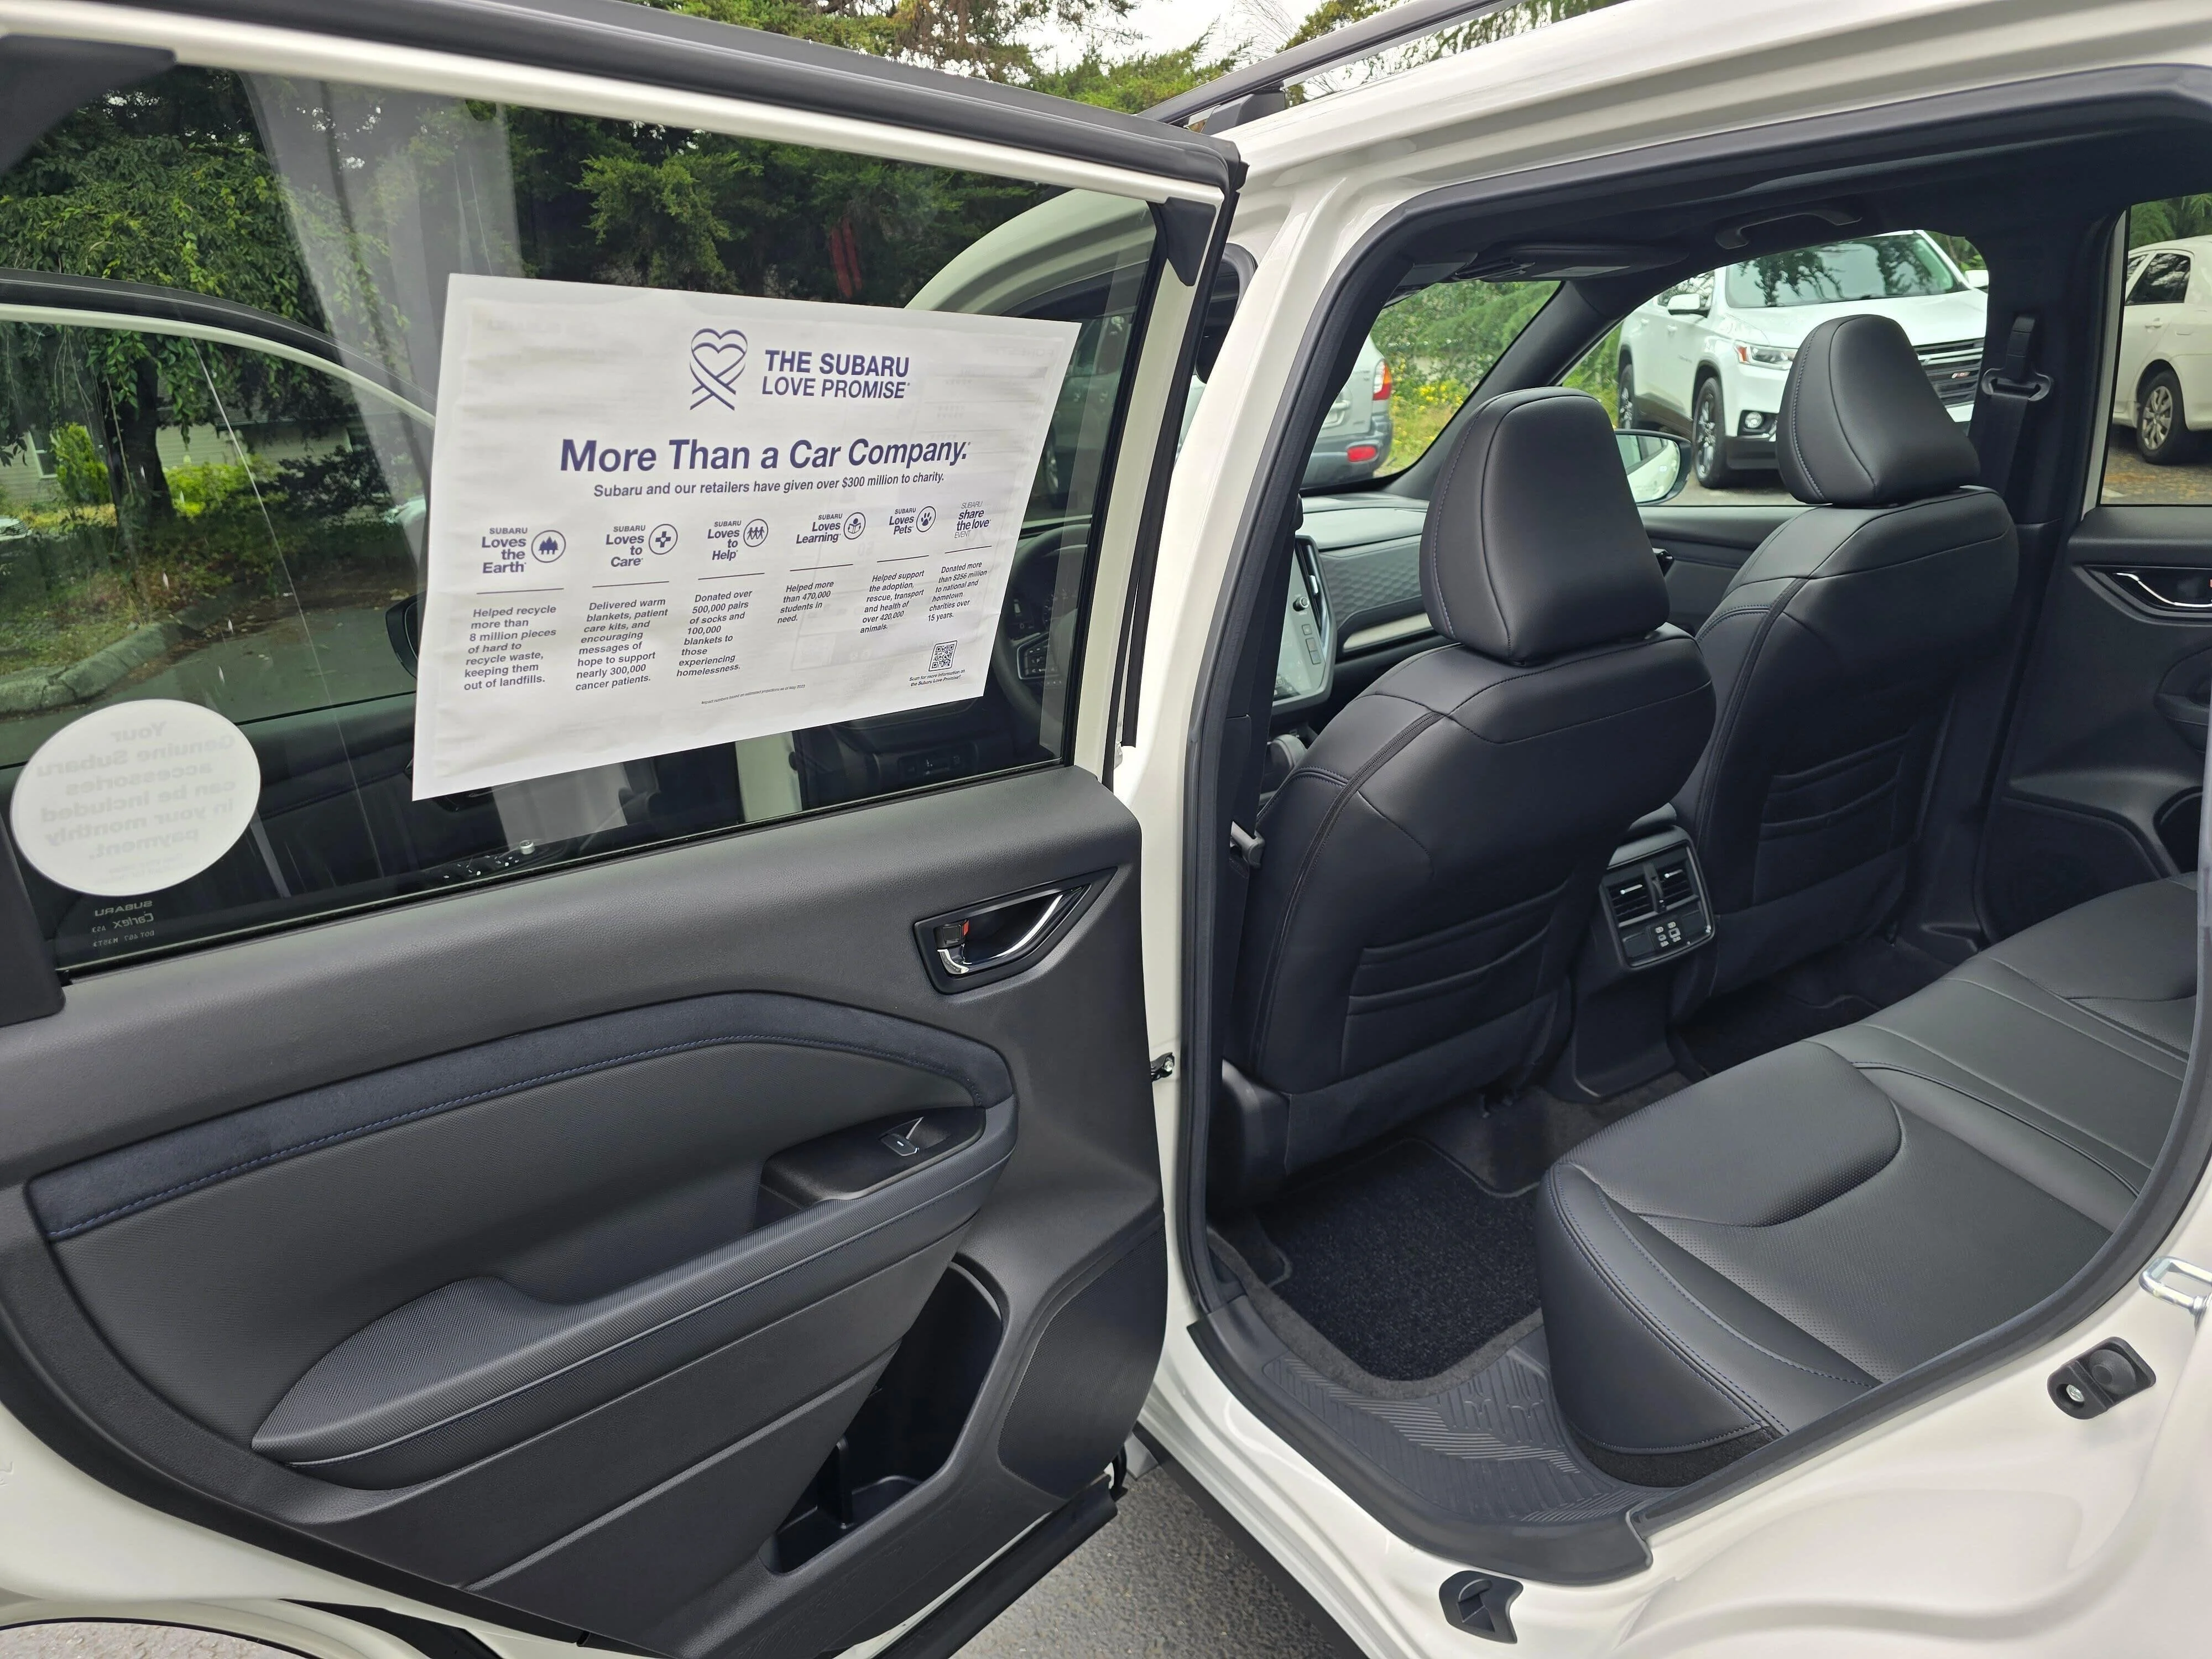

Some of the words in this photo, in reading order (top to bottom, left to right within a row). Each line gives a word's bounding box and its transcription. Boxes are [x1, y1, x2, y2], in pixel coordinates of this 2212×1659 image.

[765, 349, 812, 373] THE
[820, 353, 909, 377] SUBARU
[762, 376, 816, 396] LOVE
[822, 380, 905, 398] PROMISE
[561, 439, 656, 472] More
[669, 439, 749, 469] Than
[761, 447, 778, 469] a
[790, 440, 841, 468] Car
[594, 484, 642, 497] Subaru
[646, 482, 670, 494] and
[675, 485, 696, 493] our
[701, 482, 749, 493] retailers
[754, 481, 780, 492] have
[784, 480, 813, 492] given
[817, 480, 839, 489] over
[842, 477, 864, 489] $300
[867, 474, 898, 486] million
[901, 475, 910, 483] to
[913, 472, 943, 483] charity.
[958, 509, 984, 520] share
[889, 516, 914, 525] Loves
[957, 520, 971, 531] the
[812, 522, 841, 531] Loves
[606, 534, 644, 545] Loves
[708, 529, 740, 539] Loves
[482, 536, 526, 547] Loves
[728, 539, 738, 548] to
[501, 549, 525, 560] the
[630, 546, 643, 555] to
[941, 564, 966, 573] Donated
[872, 573, 897, 582] Helped
[898, 570, 924, 580] support
[786, 582, 813, 593] Helped
[882, 582, 914, 591] adoption,
[943, 582, 967, 591] national
[695, 592, 731, 602] Donated
[802, 591, 831, 600] 470,000
[895, 589, 924, 599] transport
[932, 592, 963, 603] hometown
[589, 600, 637, 610] Delivered
[692, 603, 726, 614] 500,000
[728, 601, 749, 612] pairs
[780, 603, 813, 613] students
[864, 604, 878, 613] and
[880, 603, 900, 611] health
[930, 602, 955, 611] charities
[473, 607, 513, 618] Helped
[517, 605, 556, 616] recycle
[587, 612, 631, 622] blankets,
[634, 609, 668, 620] patient
[880, 611, 904, 620] 420,000
[504, 619, 528, 627] than
[701, 615, 727, 623] socks
[729, 612, 745, 620] and
[778, 614, 797, 623] need.
[936, 613, 953, 622] years.
[688, 625, 721, 635] 100,000
[860, 624, 888, 633] animals.
[469, 633, 476, 641] 8
[480, 632, 518, 641] million
[521, 630, 556, 640] pieces
[581, 632, 643, 643] encouraging
[684, 637, 722, 645] blankets
[468, 645, 480, 654] of
[482, 643, 508, 652] hard
[579, 644, 629, 655] messages
[466, 655, 506, 665] recycle
[510, 652, 543, 661] waste,
[578, 659, 602, 667] hope
[618, 652, 655, 664] support
[679, 655, 735, 667] experiencing
[465, 667, 508, 677] keeping
[577, 669, 607, 679] nearly
[611, 664, 646, 675] 300,000
[677, 665, 740, 676] homelessness.
[464, 681, 482, 690] out
[486, 679, 497, 687] of
[500, 675, 545, 686] landfills.
[576, 681, 609, 690] cancer
[612, 675, 650, 688] patients.
